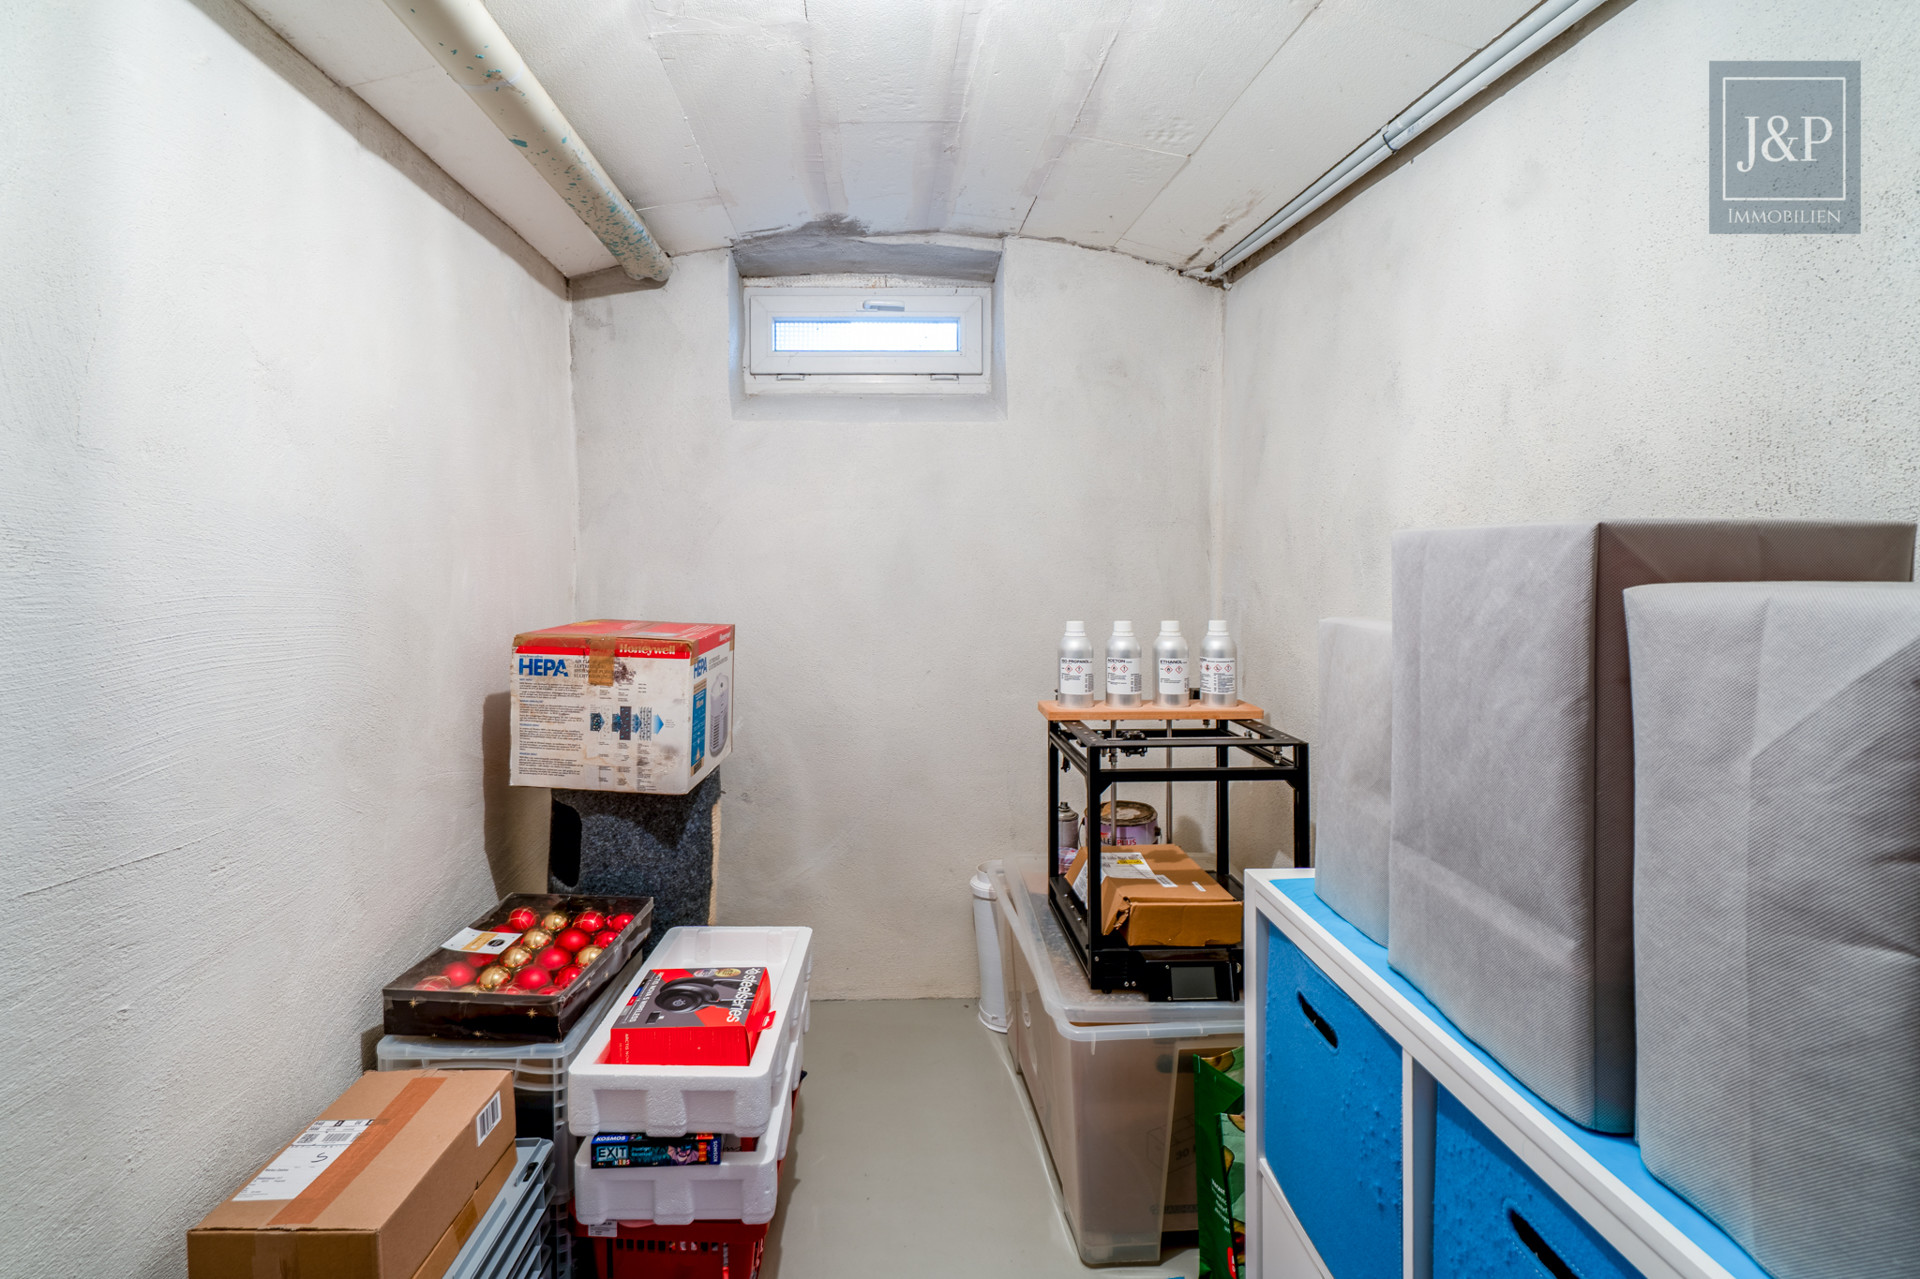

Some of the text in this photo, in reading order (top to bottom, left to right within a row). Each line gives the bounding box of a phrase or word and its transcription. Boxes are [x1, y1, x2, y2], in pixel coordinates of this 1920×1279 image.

[619, 644, 676, 656] Honeywell
[519, 658, 569, 677] HEPA
[694, 657, 708, 679] HEPA
[725, 975, 755, 1022] steelseries
[628, 1000, 648, 1022] WIRELESS
[598, 1147, 627, 1160] EXIT
